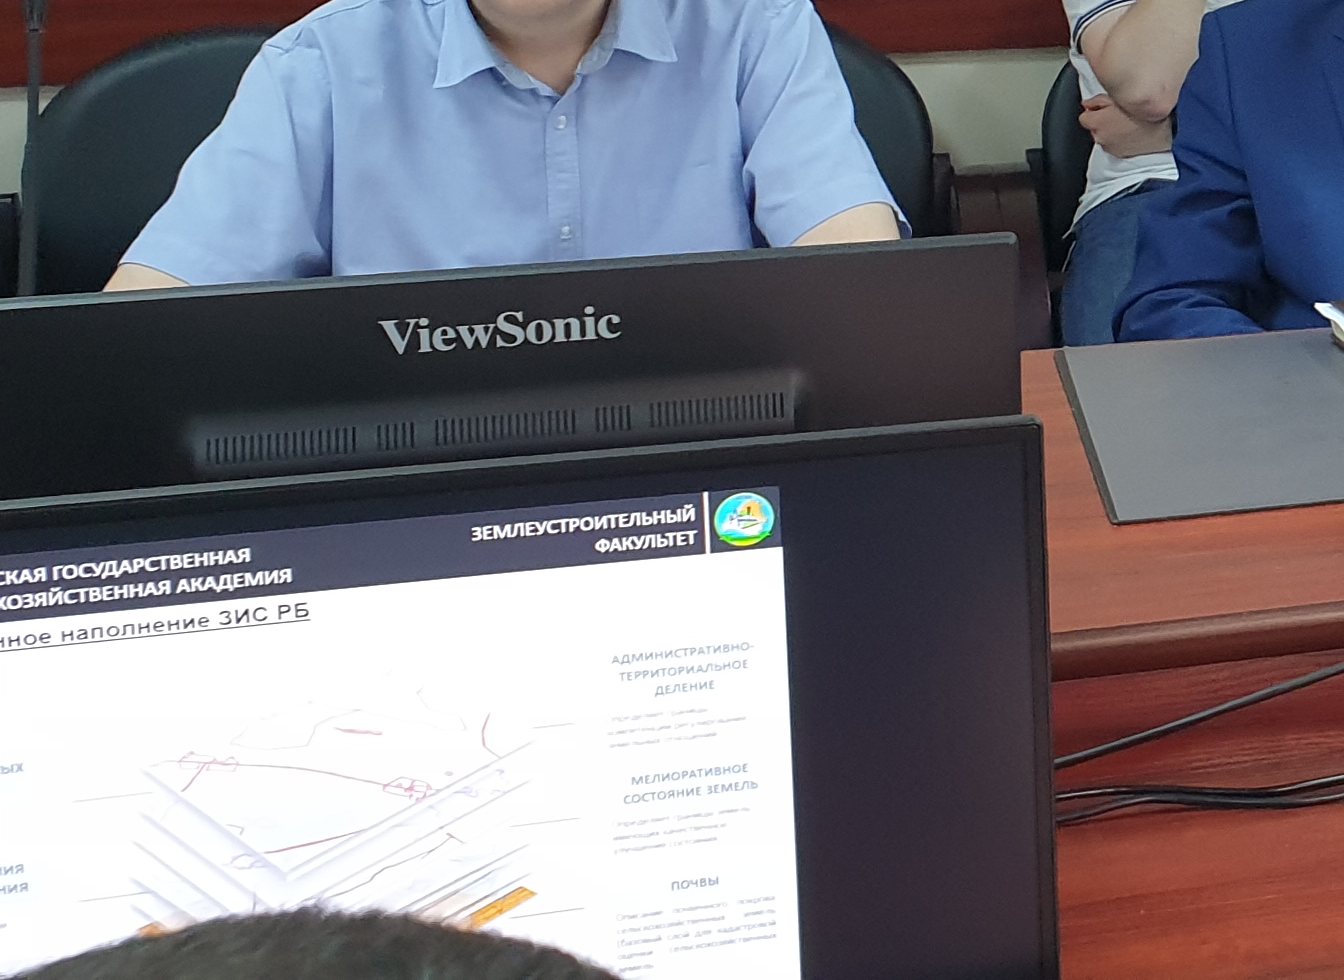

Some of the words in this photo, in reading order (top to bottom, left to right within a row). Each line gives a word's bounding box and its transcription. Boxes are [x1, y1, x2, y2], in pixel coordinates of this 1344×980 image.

[379, 305, 622, 356] ViewSonic
[471, 504, 697, 542] ЗЕМЛЕУСТРОИТЕЛЬНЫЙ
[595, 530, 698, 553] ФАКУЛЬТЕТ
[52, 547, 251, 582] ГОСУДАРСТВЕННАЯ
[177, 568, 293, 595] АКАДЕМИЯ
[61, 615, 210, 643] наполнение
[219, 606, 268, 627] ЗИС
[278, 602, 310, 621] РБ
[611, 642, 755, 665] АДМИНИСТРАТИВНО-
[619, 659, 748, 682] ТЕРРИТОРИАЛЬНОЕ
[655, 680, 715, 697] ДЕЛЕНИЕ
[631, 763, 748, 786] МЕЛИОРАТИВНОЕ
[623, 786, 701, 805] СОСТОЯНИЕ
[707, 780, 758, 795] ЗЕМЕЛЬ
[671, 876, 719, 891] ПОЧВЫ
